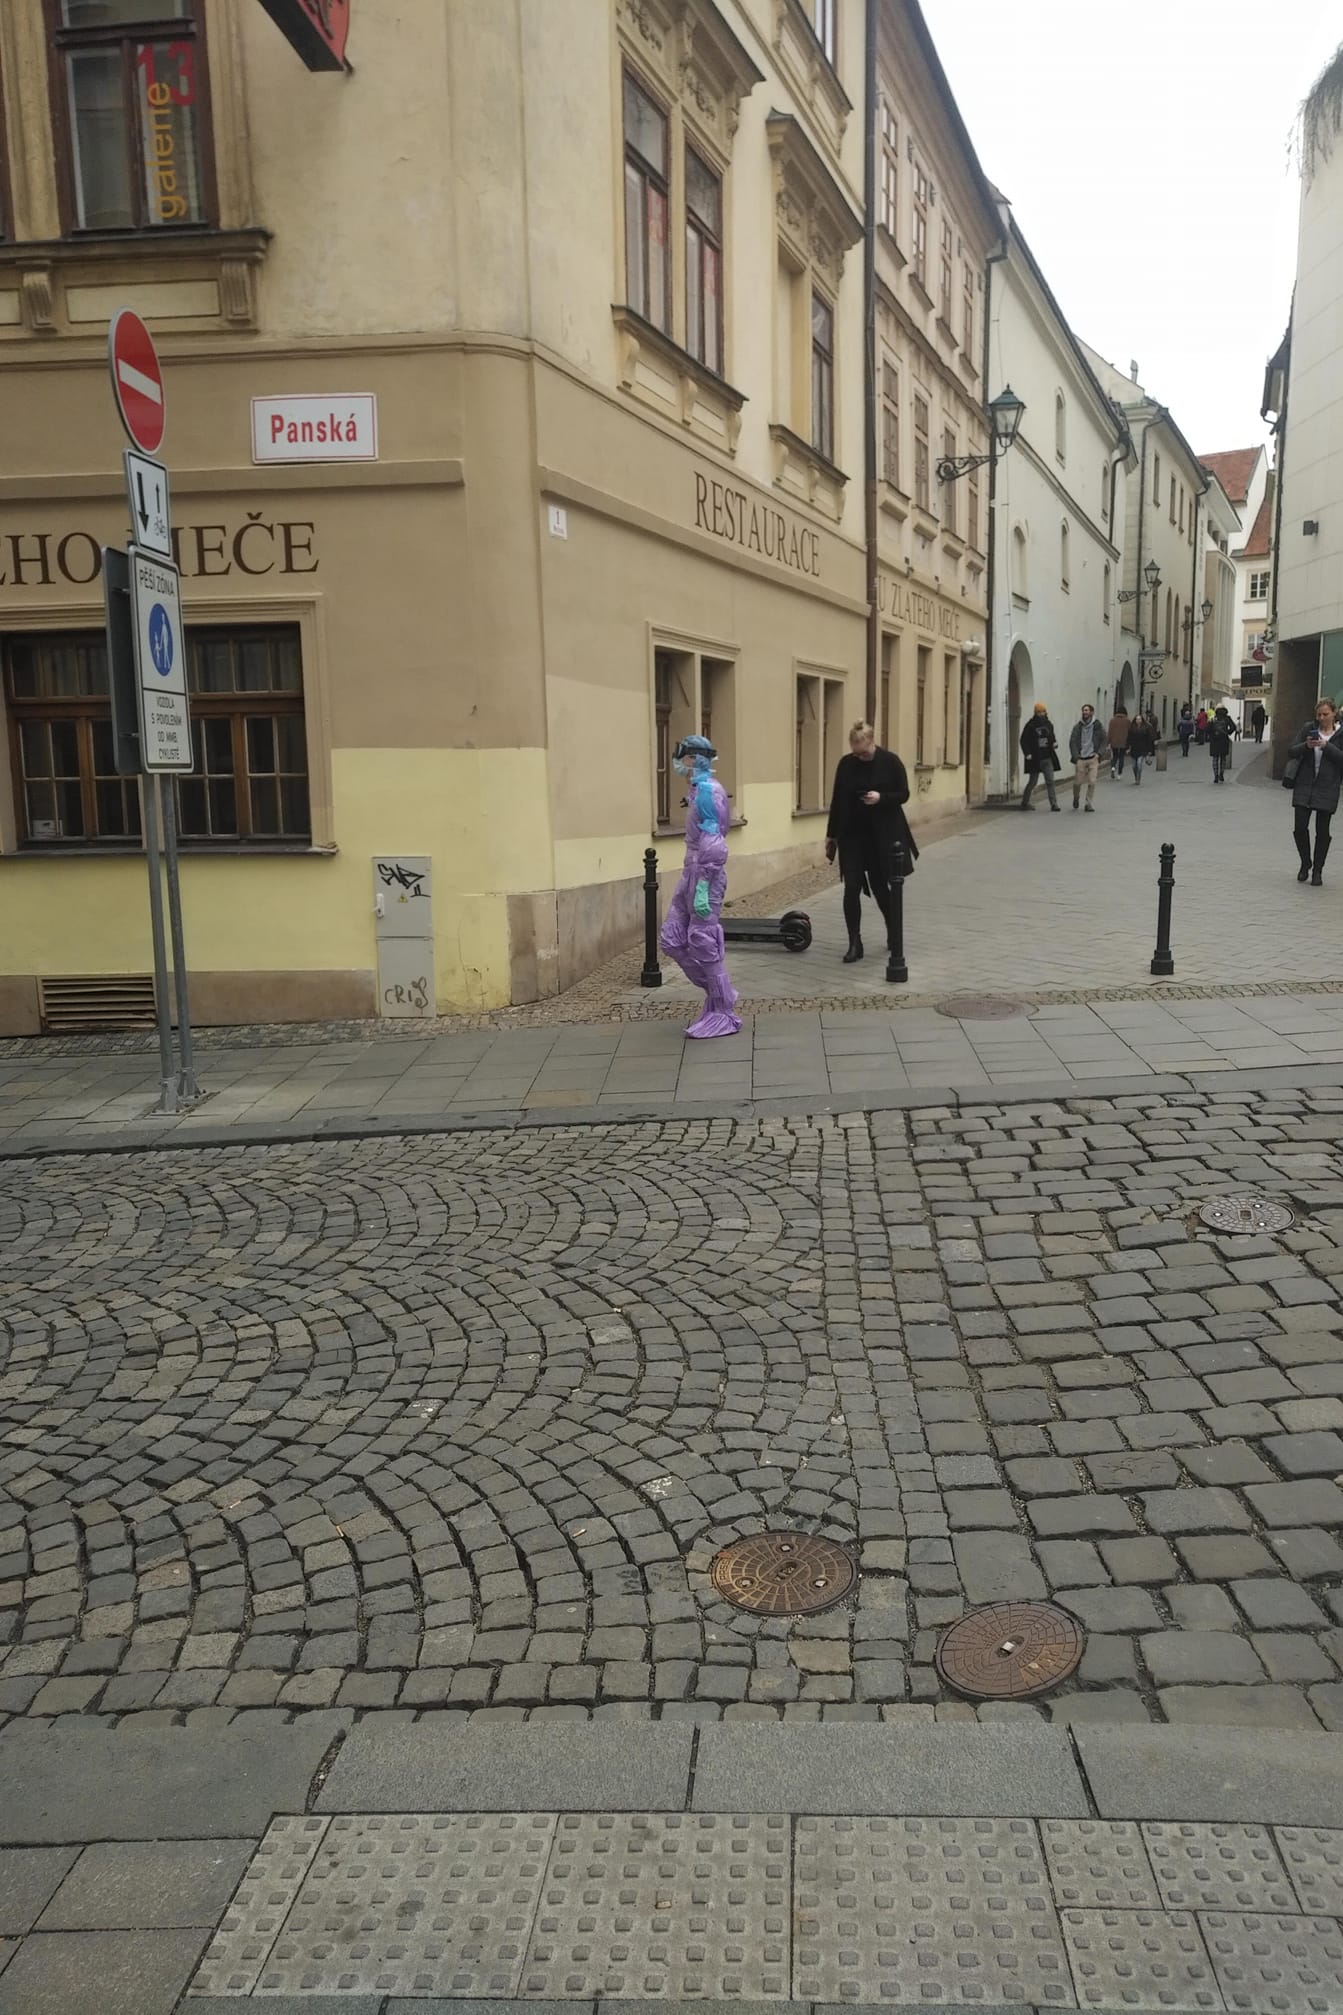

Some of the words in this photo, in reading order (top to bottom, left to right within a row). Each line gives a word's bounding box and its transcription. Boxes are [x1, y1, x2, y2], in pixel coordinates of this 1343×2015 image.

[270, 413, 358, 444] Panská
[694, 471, 820, 578] RESTAURACE
[0, 531, 102, 586] HO
[156, 573, 176, 598] ZÓNA
